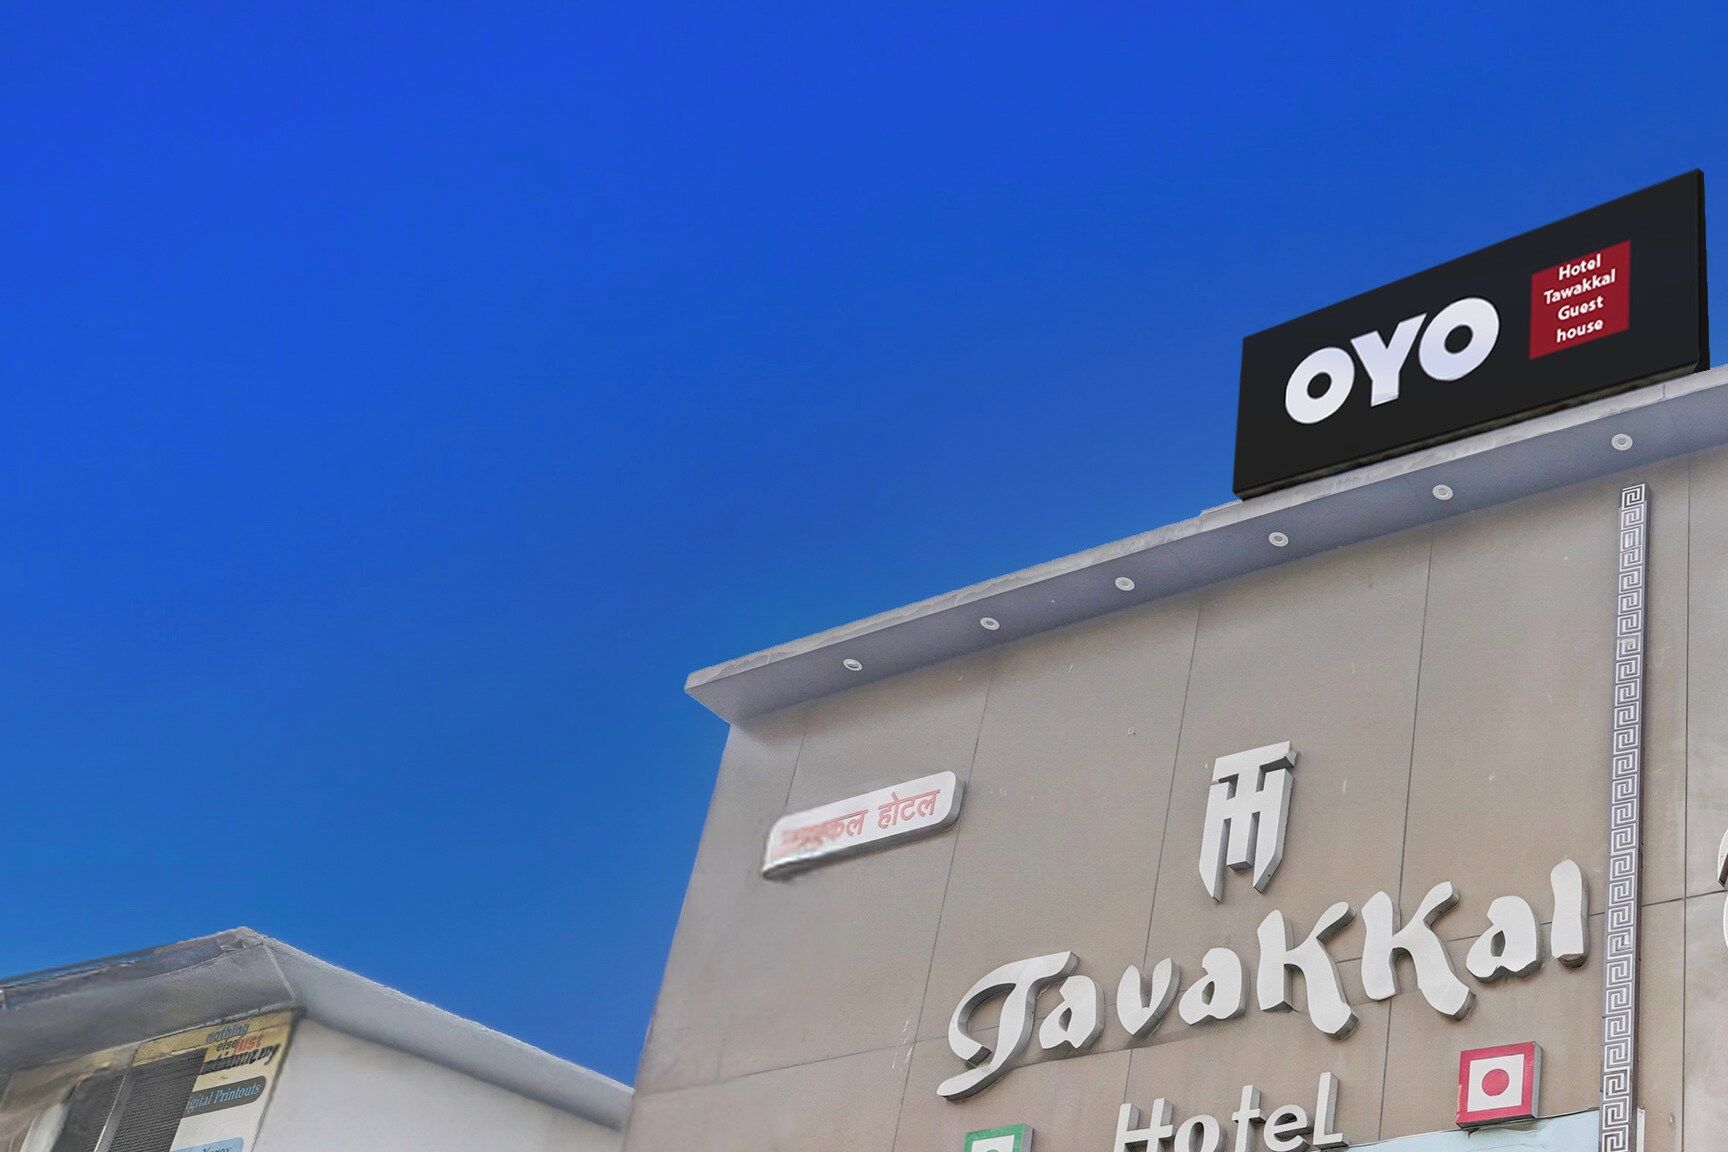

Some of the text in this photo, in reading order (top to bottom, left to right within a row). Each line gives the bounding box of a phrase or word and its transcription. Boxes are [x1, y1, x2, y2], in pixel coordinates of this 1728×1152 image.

[1558, 254, 1601, 281] Hotel
[1544, 269, 1616, 305] Tawakkal
[1557, 296, 1604, 322] Guest
[1556, 317, 1604, 343] house
[1285, 297, 1500, 424] OYO
[877, 791, 941, 829] होटल
[214, 1082, 261, 1104] Printouts
